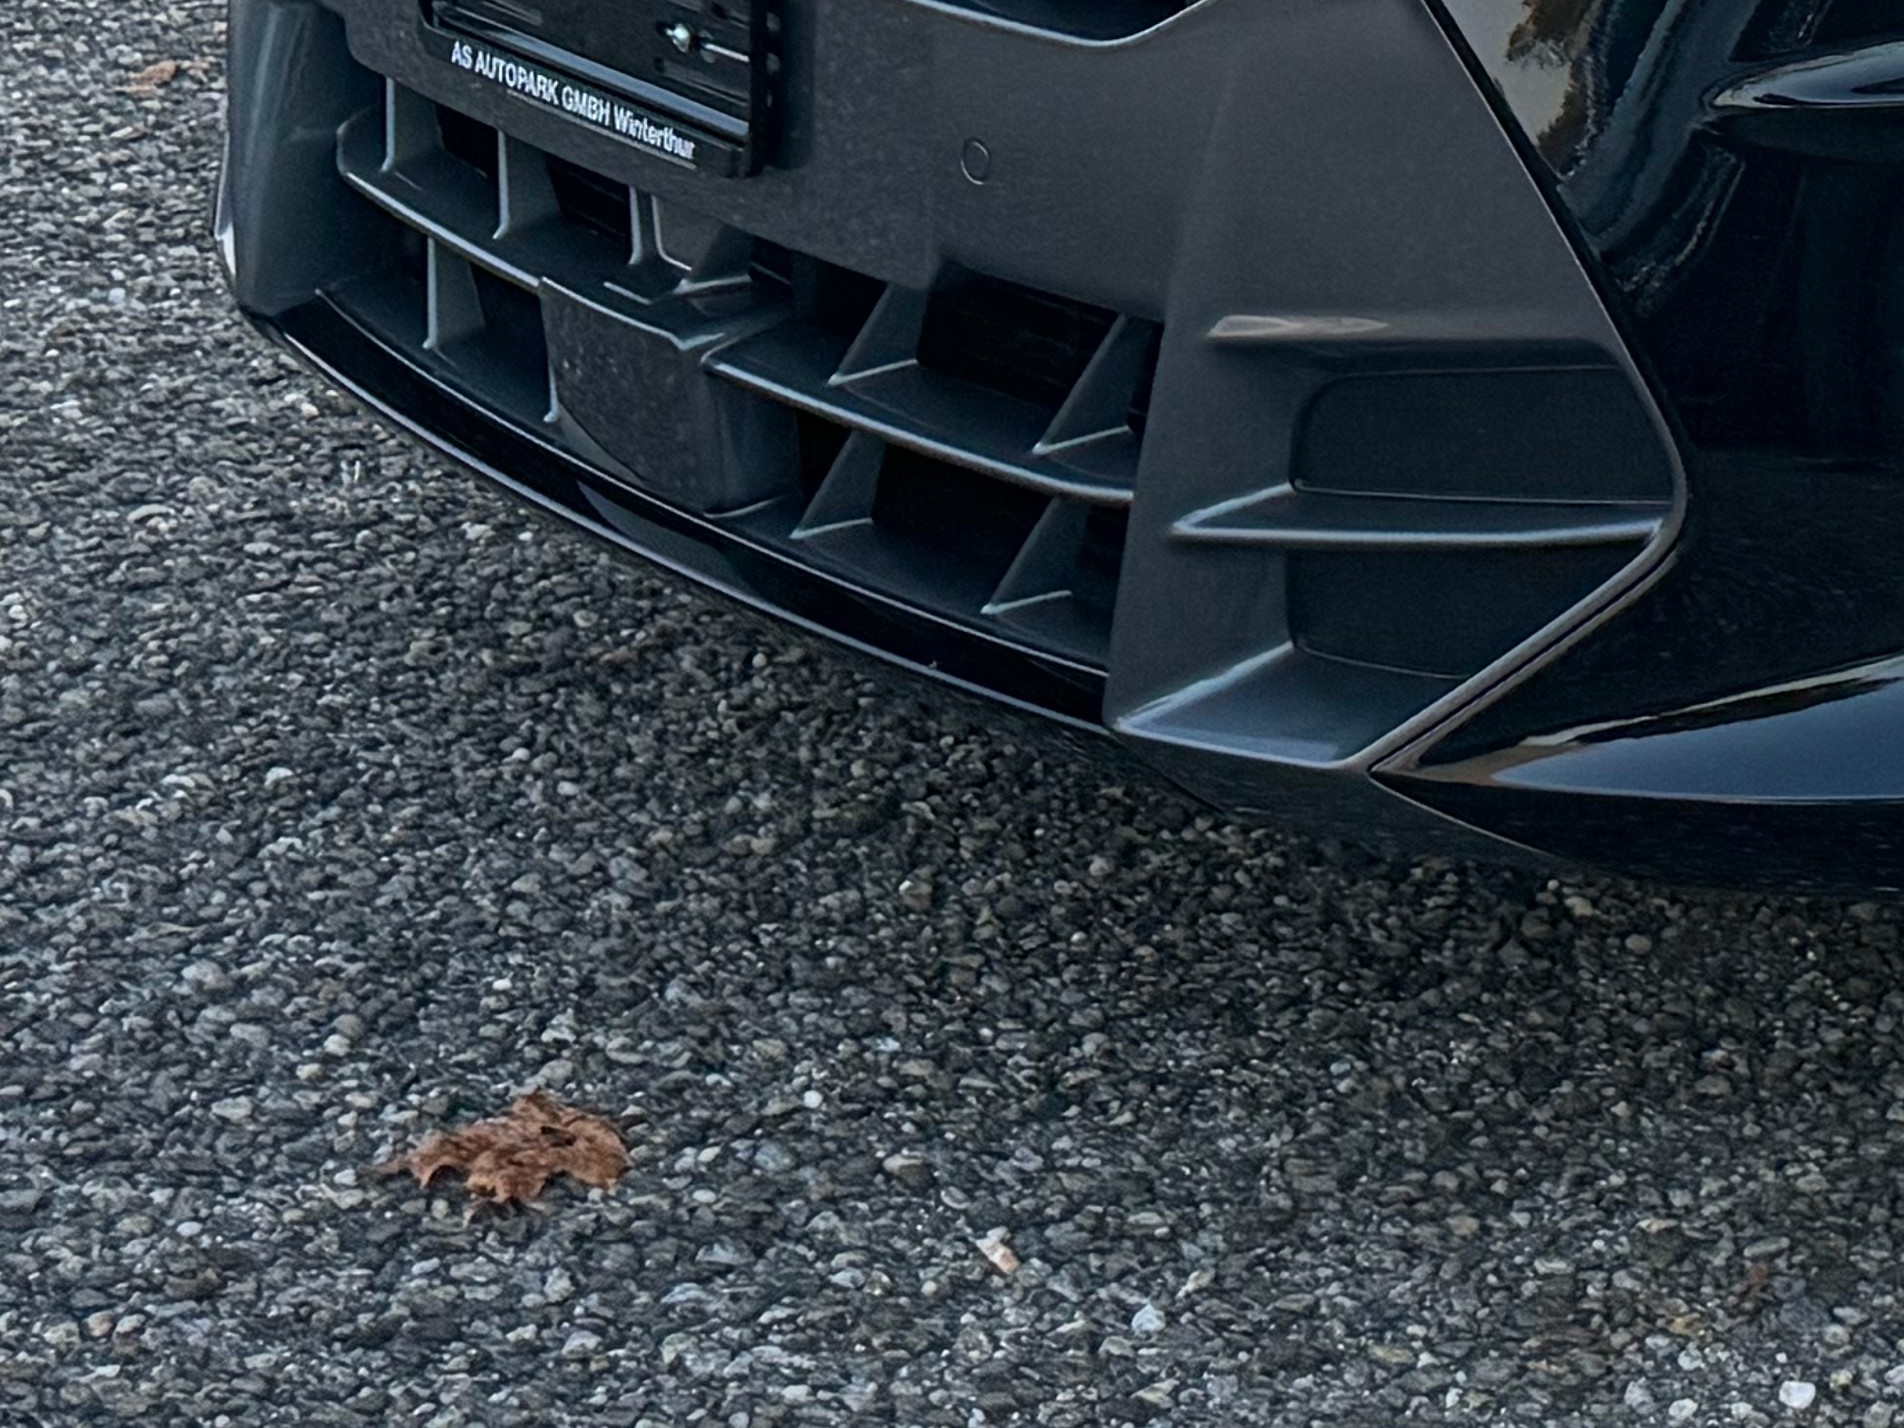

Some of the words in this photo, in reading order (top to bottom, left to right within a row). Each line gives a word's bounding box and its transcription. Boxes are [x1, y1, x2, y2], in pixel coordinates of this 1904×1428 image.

[450, 38, 474, 70] AS
[474, 48, 560, 107] AUTOPARK
[561, 85, 612, 127] GMBH
[613, 102, 696, 161] Winterthur
